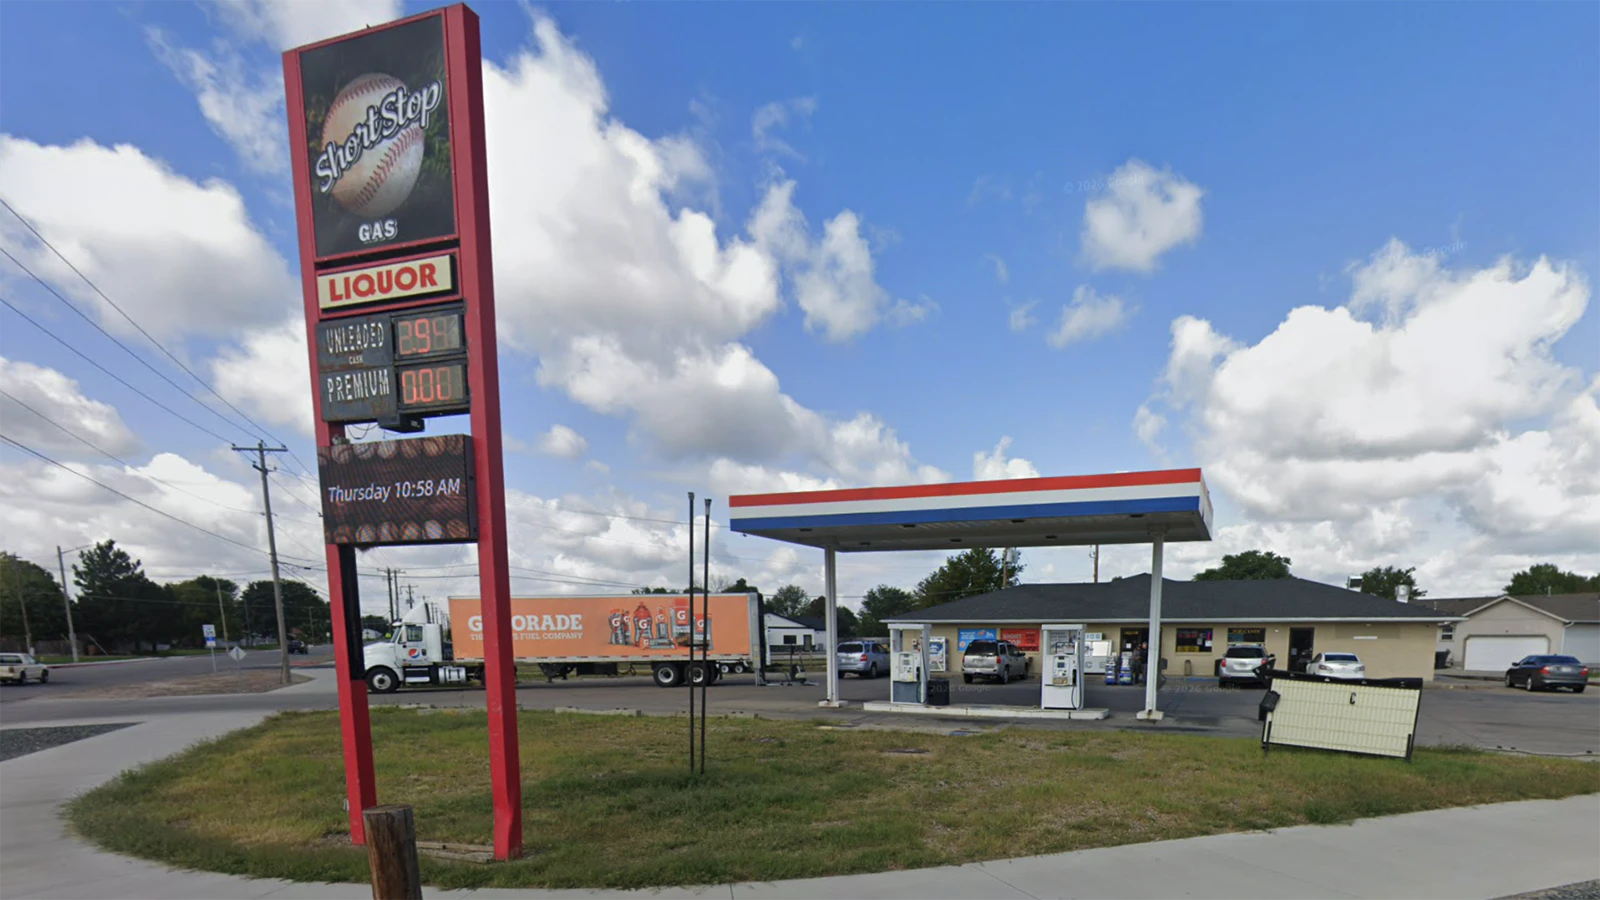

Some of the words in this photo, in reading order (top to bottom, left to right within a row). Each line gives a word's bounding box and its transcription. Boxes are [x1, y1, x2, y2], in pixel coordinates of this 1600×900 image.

[358, 219, 398, 243] GAS
[329, 263, 437, 302] LIQUOR
[326, 322, 384, 354] UNLEADED
[327, 369, 390, 403] PREMIUM
[328, 483, 391, 502] Thursday
[395, 480, 433, 498] 10:58
[436, 478, 460, 496] AM
[468, 614, 583, 632] GORADE
[521, 632, 541, 640] FUEL
[543, 632, 583, 640] COMPANY
